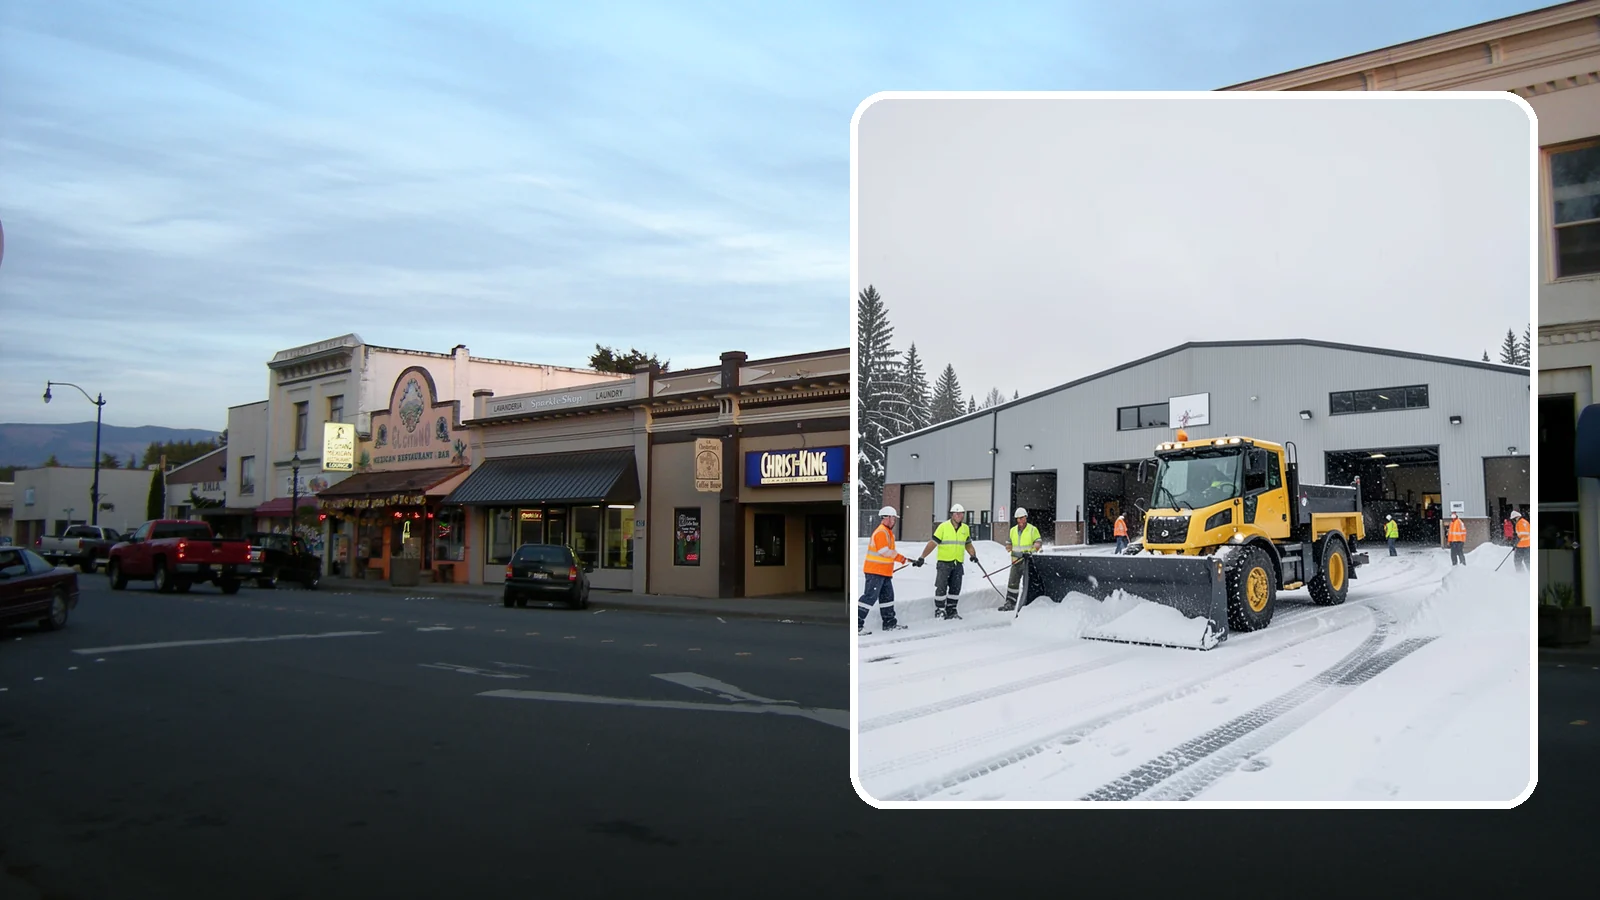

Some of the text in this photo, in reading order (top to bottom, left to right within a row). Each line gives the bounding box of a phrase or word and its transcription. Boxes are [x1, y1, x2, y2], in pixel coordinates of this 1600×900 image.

[531, 394, 582, 409] Sparkle Shop
[595, 389, 623, 400] LAUNDRY
[493, 402, 522, 413] LAVANDERIA
[374, 455, 396, 464] MEXICAN
[397, 451, 434, 462] RESTAURANT
[438, 450, 450, 459] BAR
[760, 450, 827, 478] CHRIST KING
